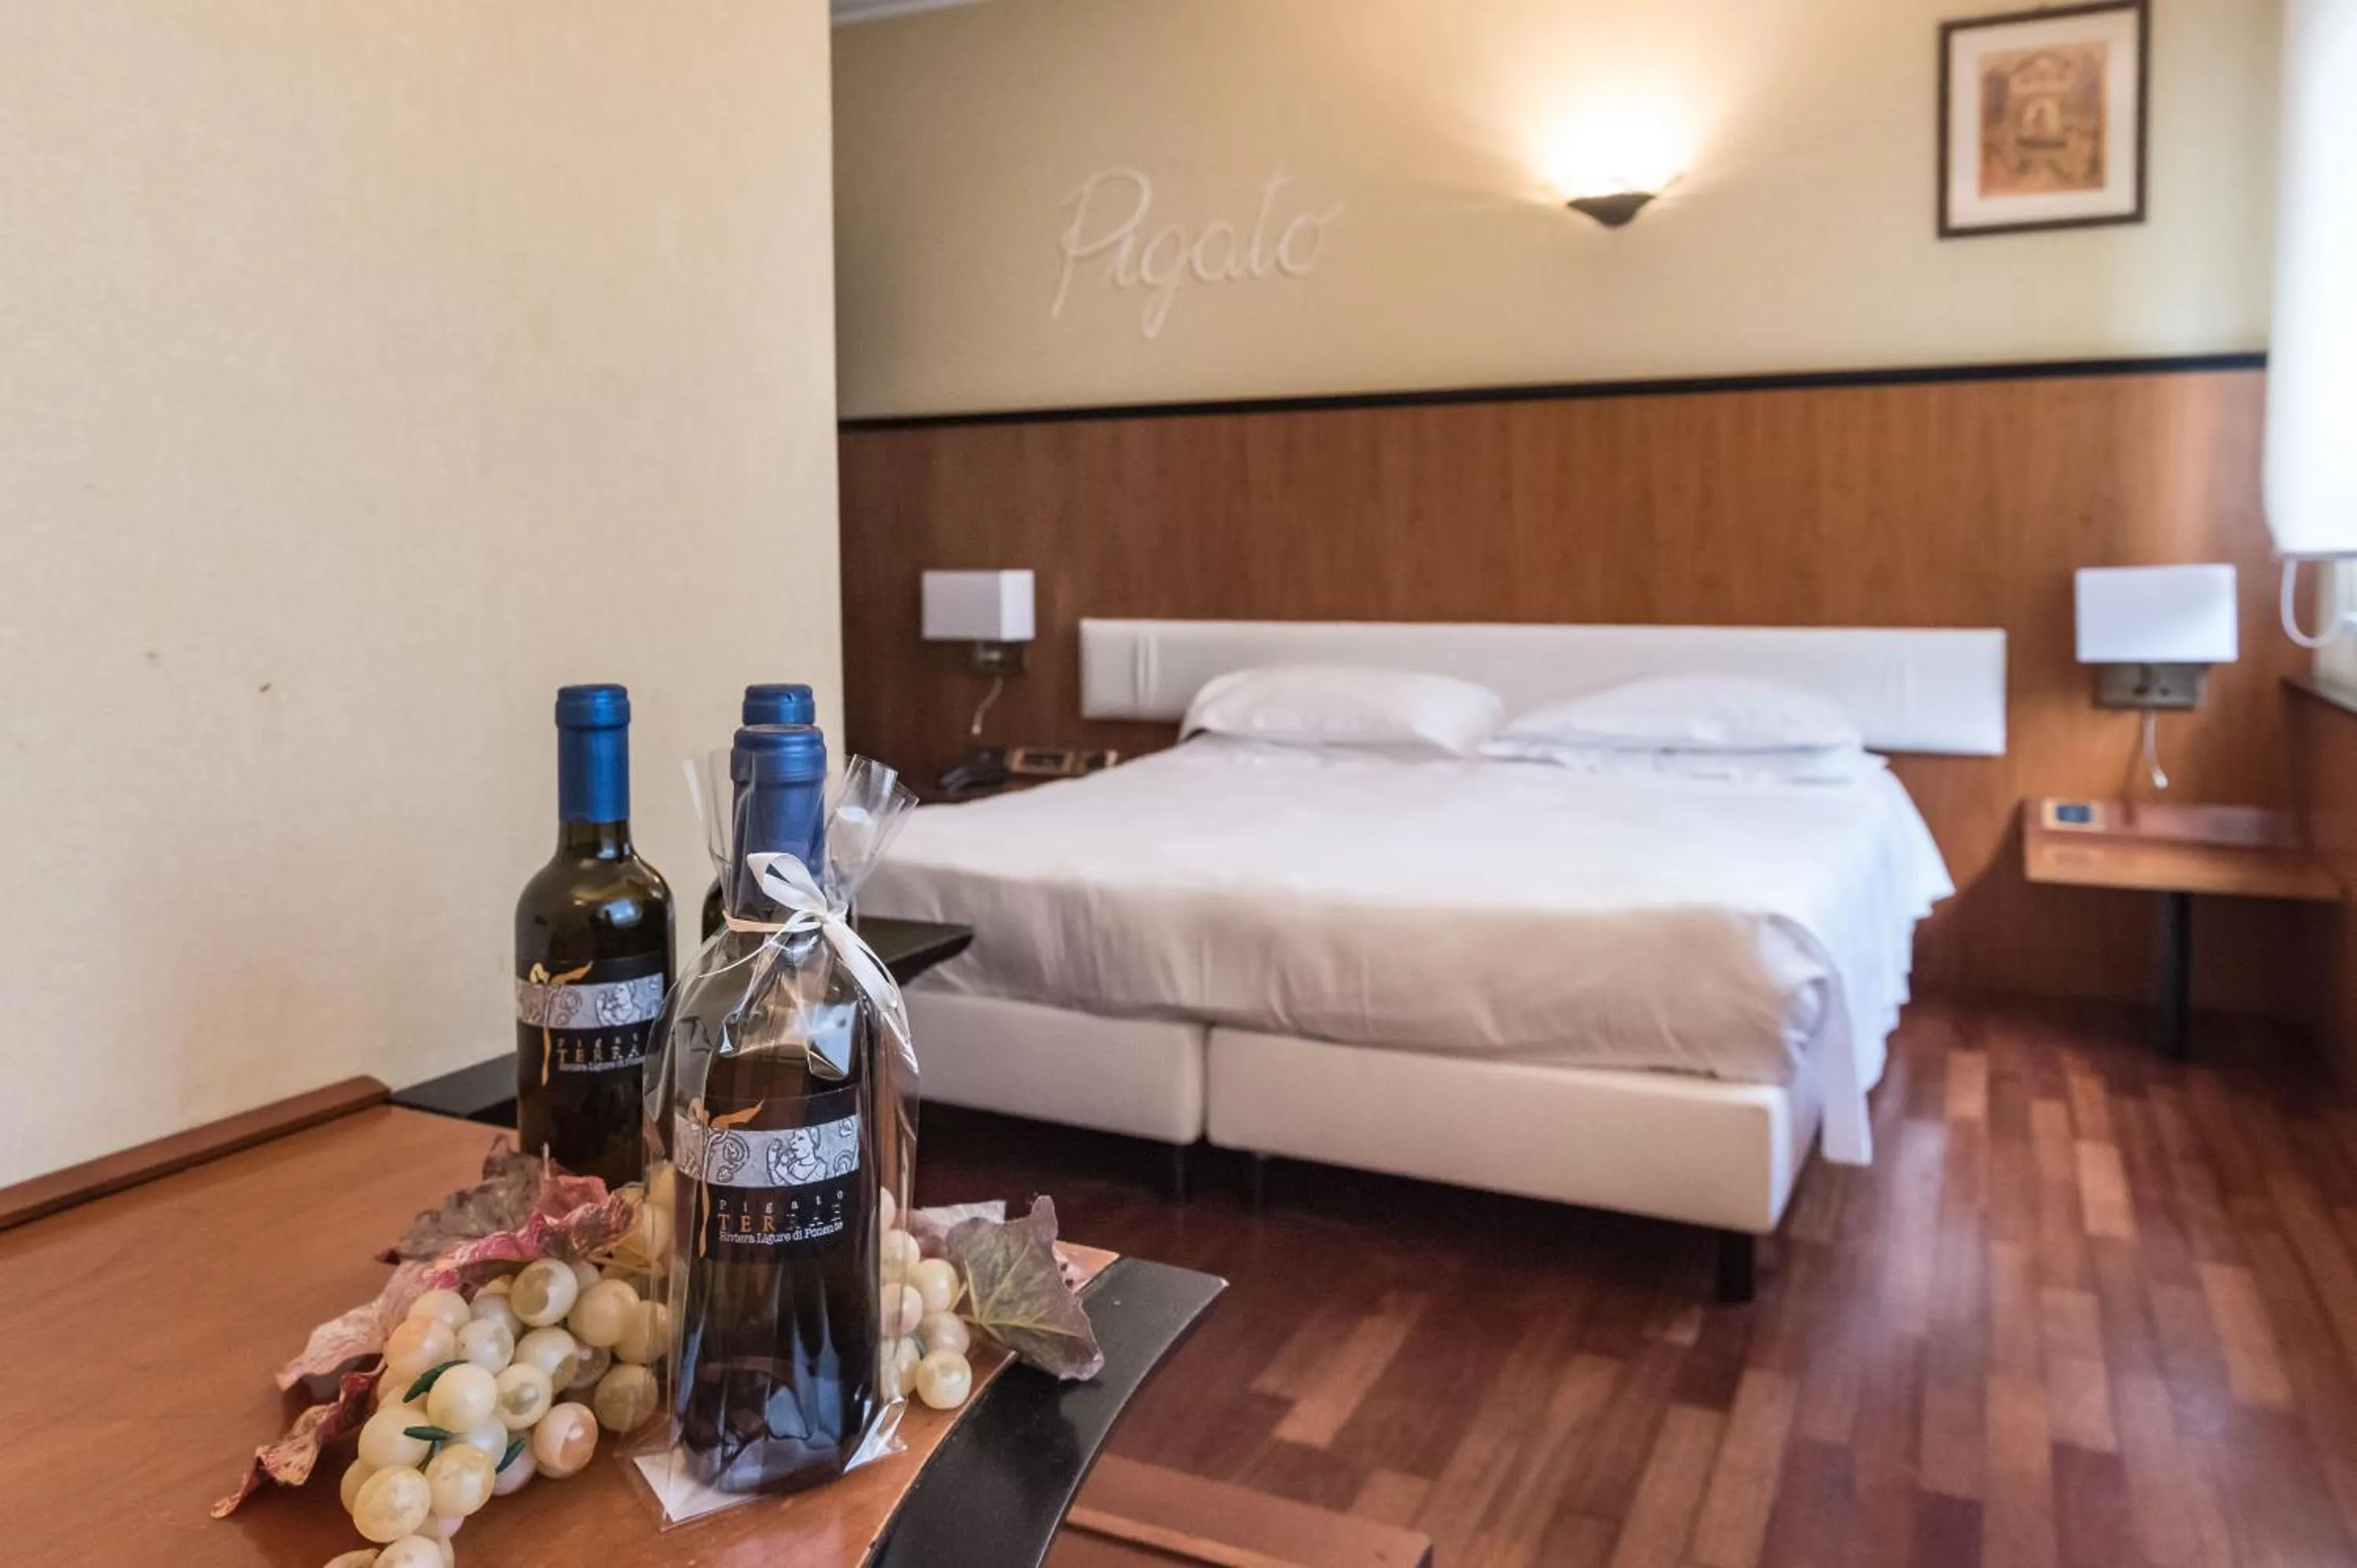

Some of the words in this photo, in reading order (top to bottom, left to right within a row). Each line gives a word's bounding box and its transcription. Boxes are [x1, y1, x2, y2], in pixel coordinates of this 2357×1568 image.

[556, 1045, 640, 1062] TERRA
[757, 1233, 791, 1245] Ligure
[793, 1228, 802, 1240] di
